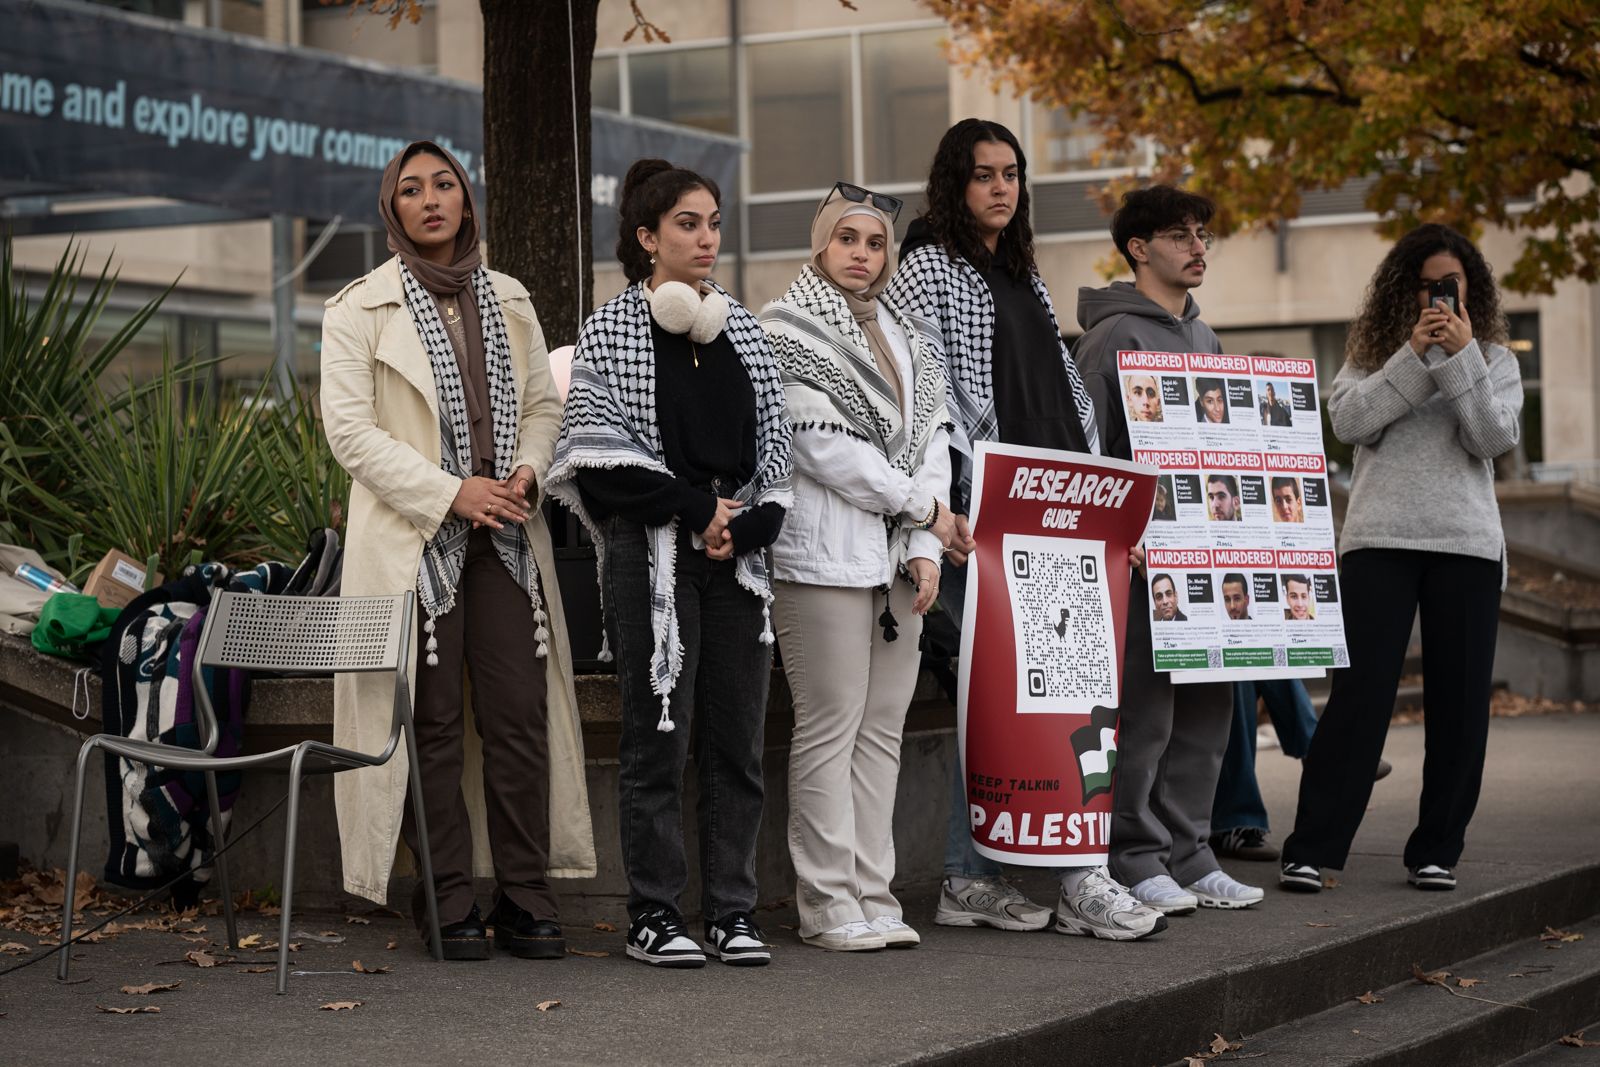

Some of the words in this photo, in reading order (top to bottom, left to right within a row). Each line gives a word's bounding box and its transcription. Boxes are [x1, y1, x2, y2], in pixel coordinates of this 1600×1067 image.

[62, 79, 127, 128] and
[133, 93, 249, 148] explore
[251, 115, 320, 161] your
[1121, 353, 1182, 368] MURDERED
[1190, 357, 1247, 371] MURDERED
[1254, 359, 1310, 374] MURDERED
[1137, 451, 1196, 466] MURDERED
[1203, 452, 1261, 467] MURDERED
[1267, 455, 1322, 470] MURDERED
[1009, 466, 1134, 508] RESEARCH
[1042, 508, 1082, 530] GUIDE
[1150, 552, 1209, 565] MURDERED
[1216, 552, 1274, 565] MURDERED
[1279, 552, 1332, 566] MURDERED
[970, 772, 1003, 789] KEEP
[1009, 779, 1060, 791] TALKING
[970, 787, 1012, 805] ABOUT
